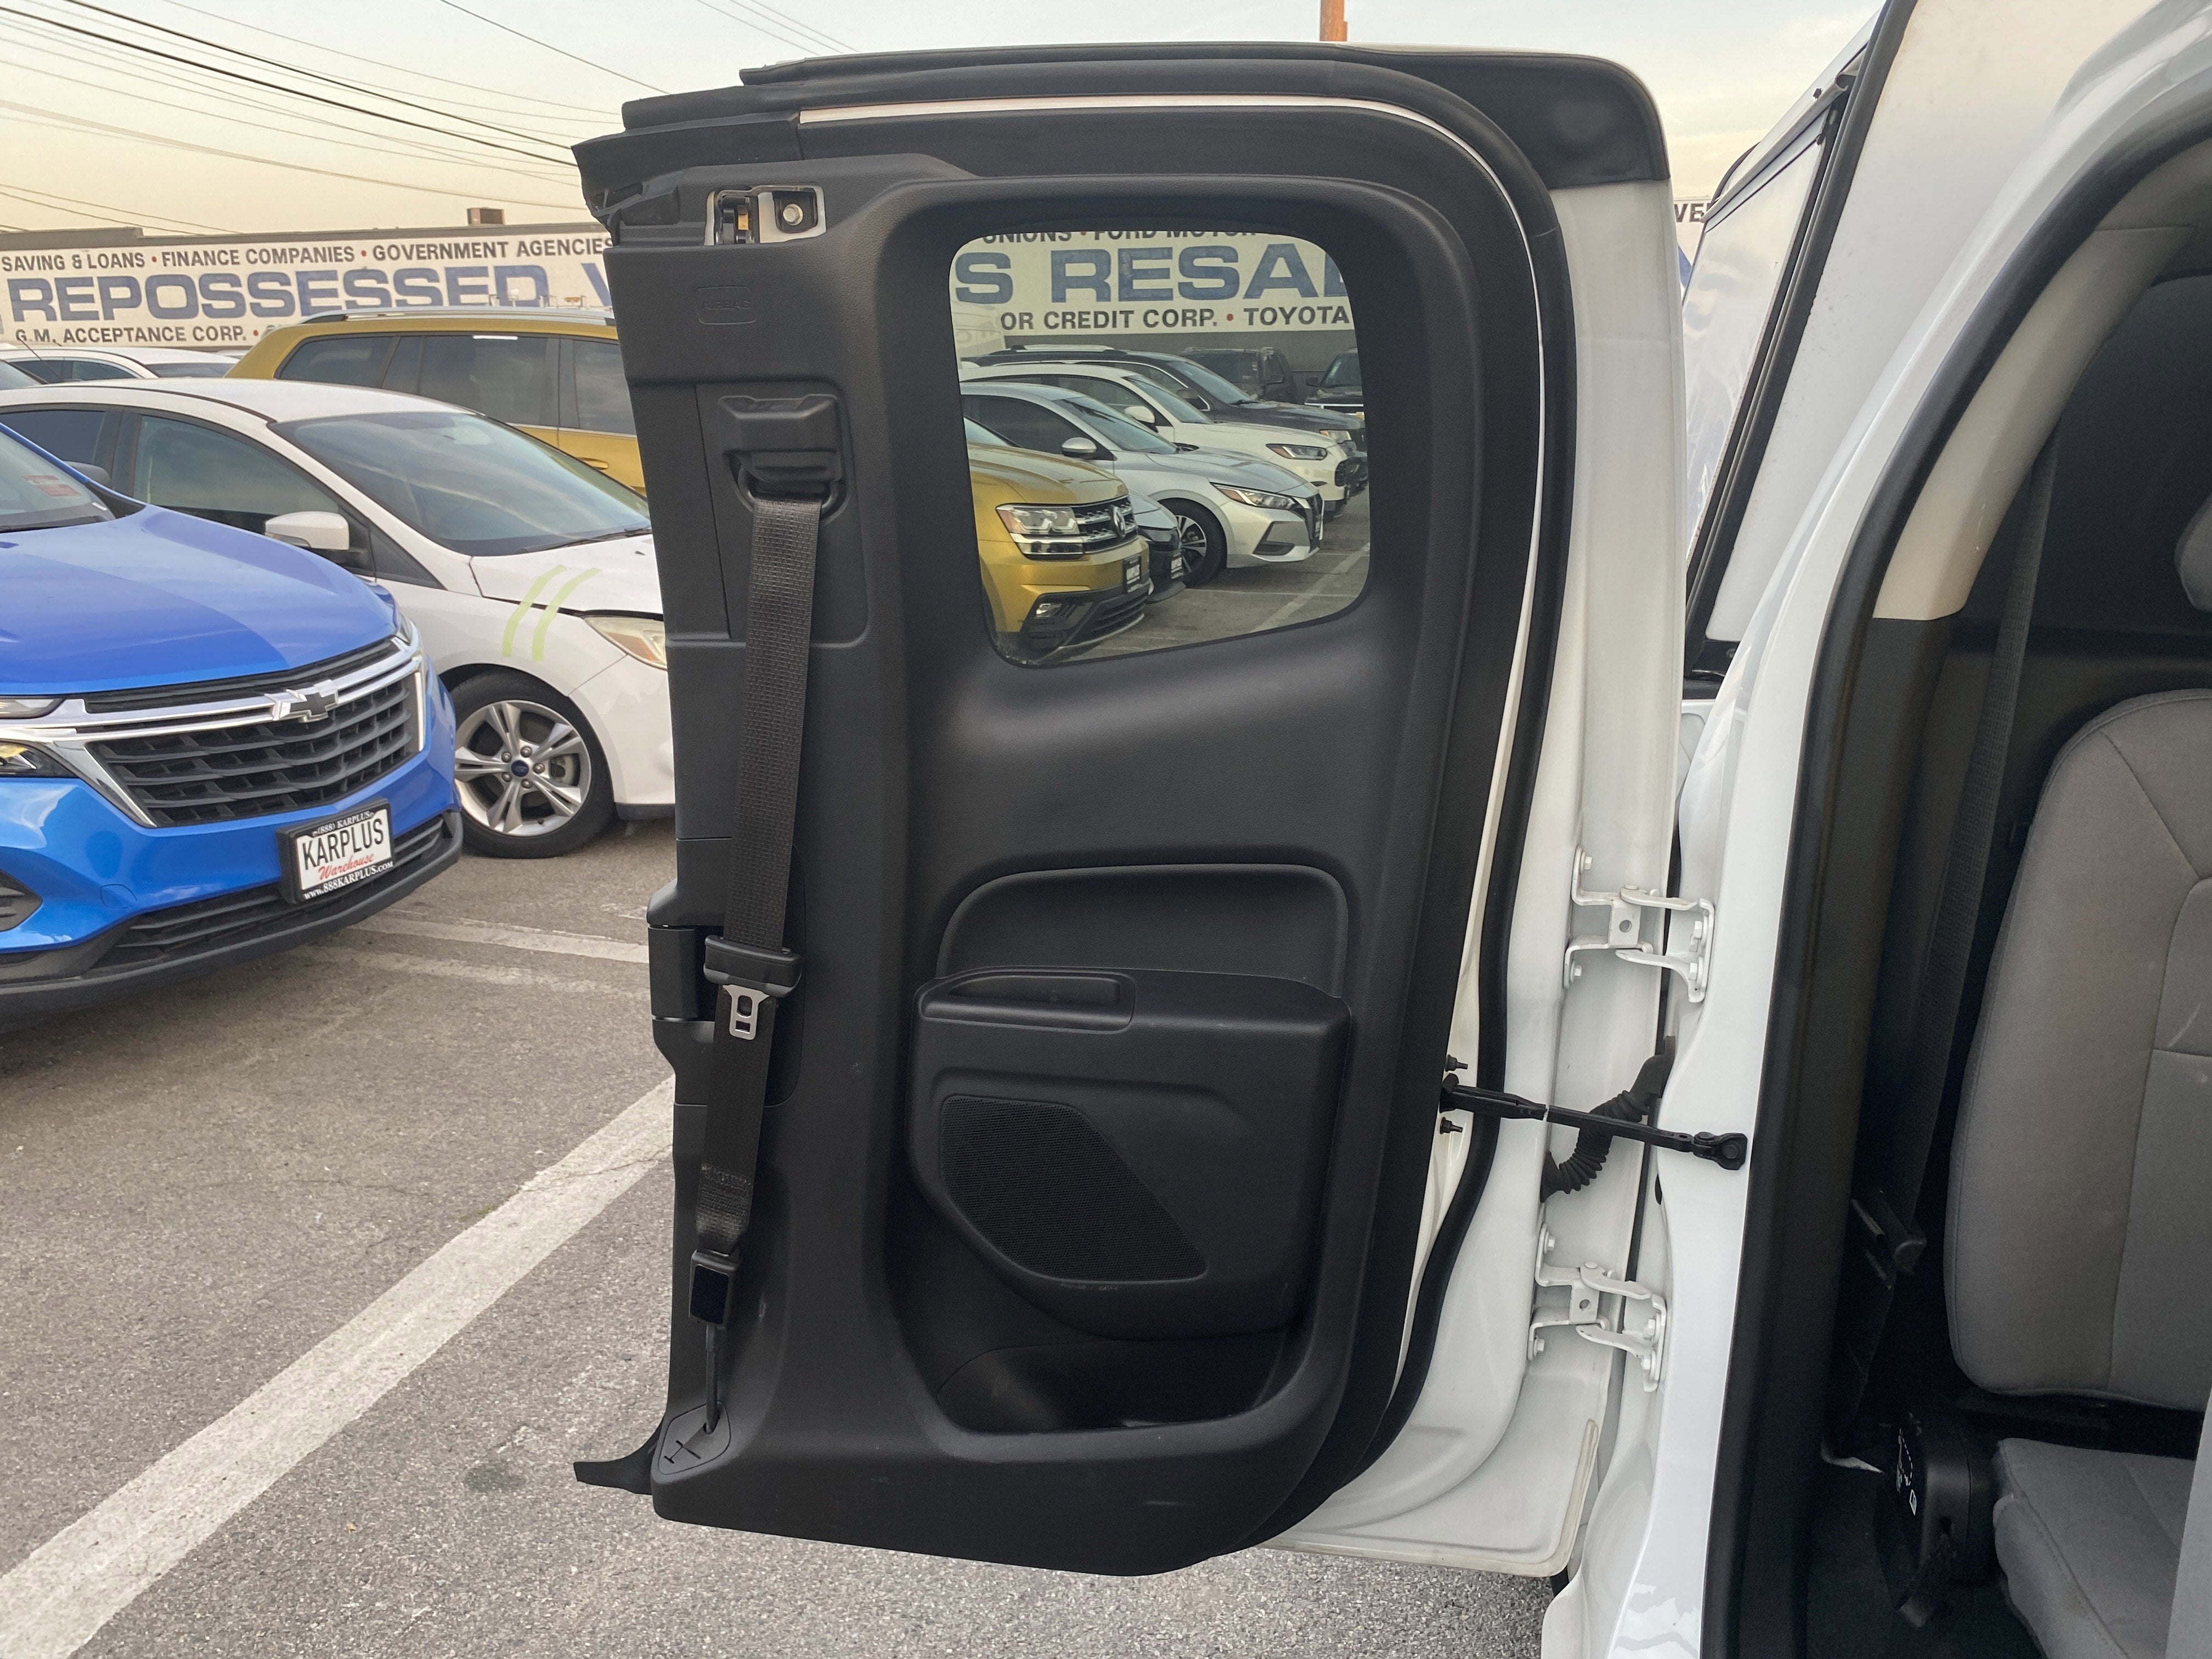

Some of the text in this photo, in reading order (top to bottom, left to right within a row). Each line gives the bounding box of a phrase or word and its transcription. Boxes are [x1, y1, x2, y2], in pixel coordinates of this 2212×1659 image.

[2, 254, 65, 271] SAVING
[72, 254, 82, 269] &
[87, 252, 145, 269] LOANS
[161, 249, 240, 267] FINANCE
[246, 246, 355, 264] COMPANIES
[373, 241, 509, 261] GOVERNMENT
[7, 265, 549, 322] REPOSSESSED
[1001, 306, 1350, 330] OR CREDIT CORP. TOYOTA
[63, 326, 187, 343] ACCEPTANCE
[193, 325, 247, 342] CORP.
[337, 810, 370, 828] KARPLUS
[302, 817, 384, 871] KARPLUS
[318, 854, 374, 880] Warehouse
